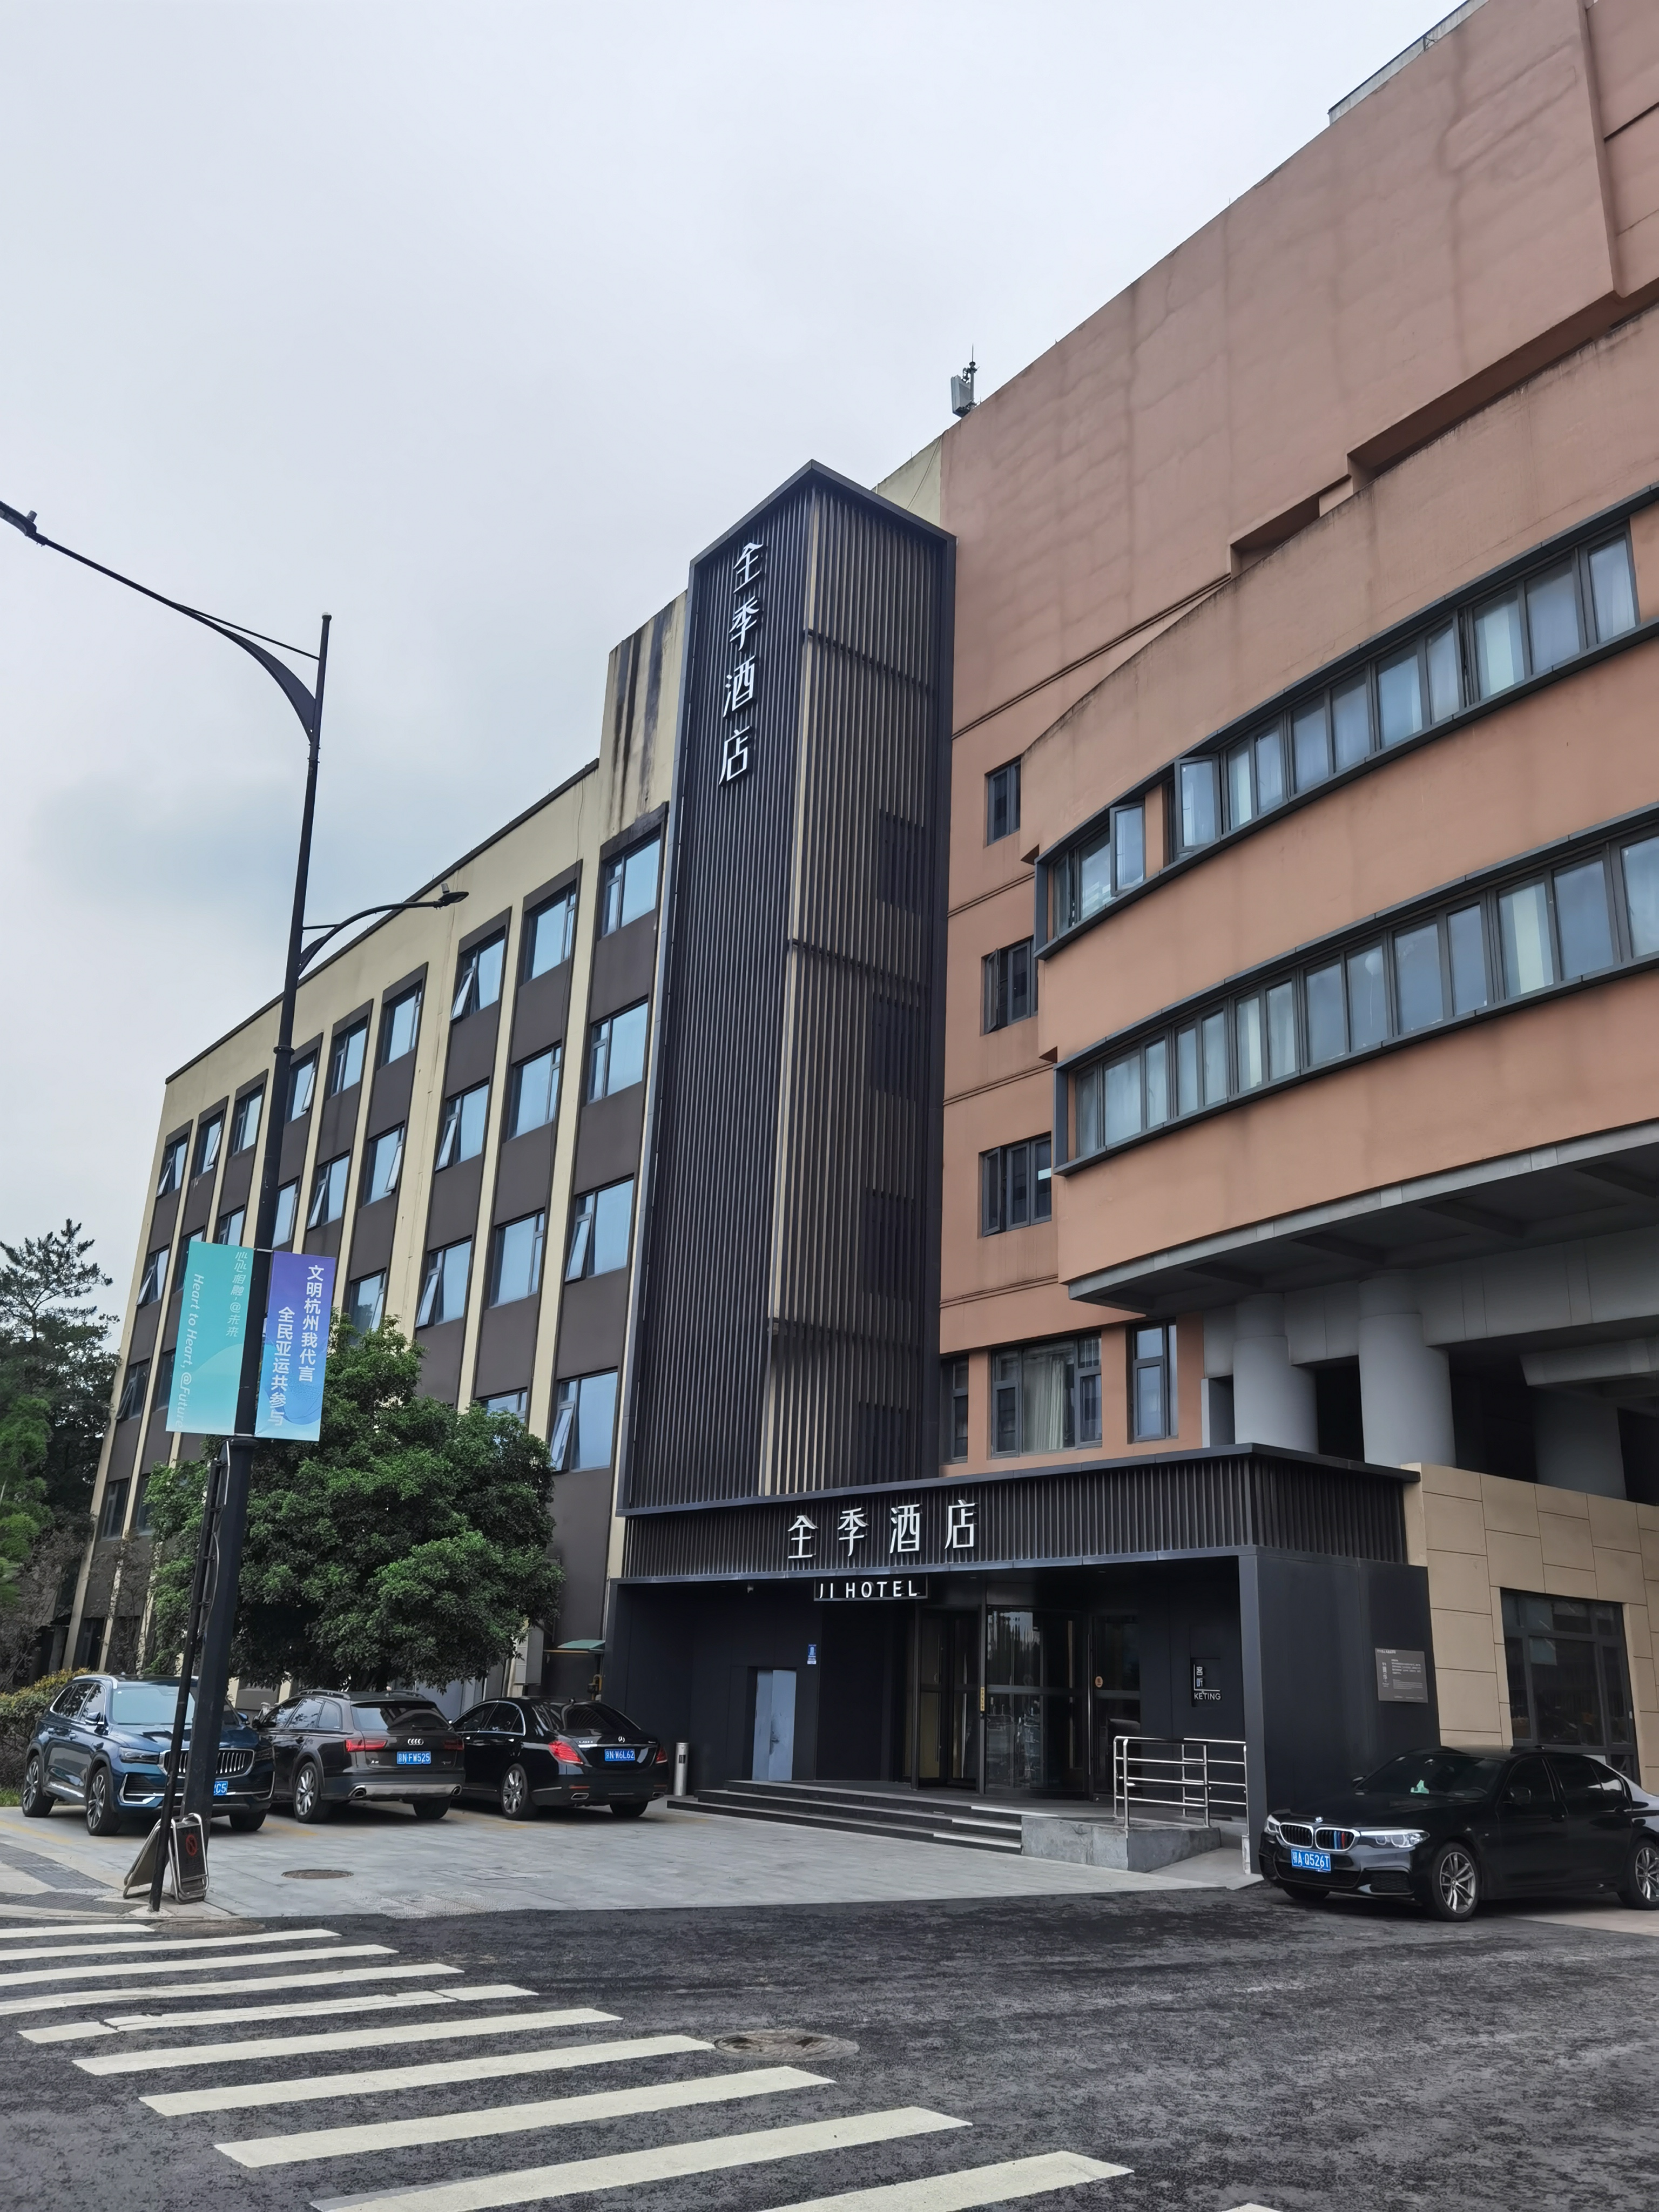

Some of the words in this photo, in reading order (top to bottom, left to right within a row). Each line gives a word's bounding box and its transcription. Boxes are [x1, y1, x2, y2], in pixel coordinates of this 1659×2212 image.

[719, 542, 763, 785] 全季酒店
[190, 1273, 204, 1310] Heart
[188, 1313, 199, 1326] to
[298, 1265, 324, 1382] 文明杭州我代言
[180, 1328, 198, 1368] Heart,
[267, 1306, 295, 1426] 全民亚运共参与
[175, 1372, 192, 1428] @Future
[787, 1499, 976, 1559] 全季酒店
[819, 1583, 833, 1599] JI
[846, 1580, 918, 1599] HOTEL
[1194, 1692, 1221, 1701] KETING
